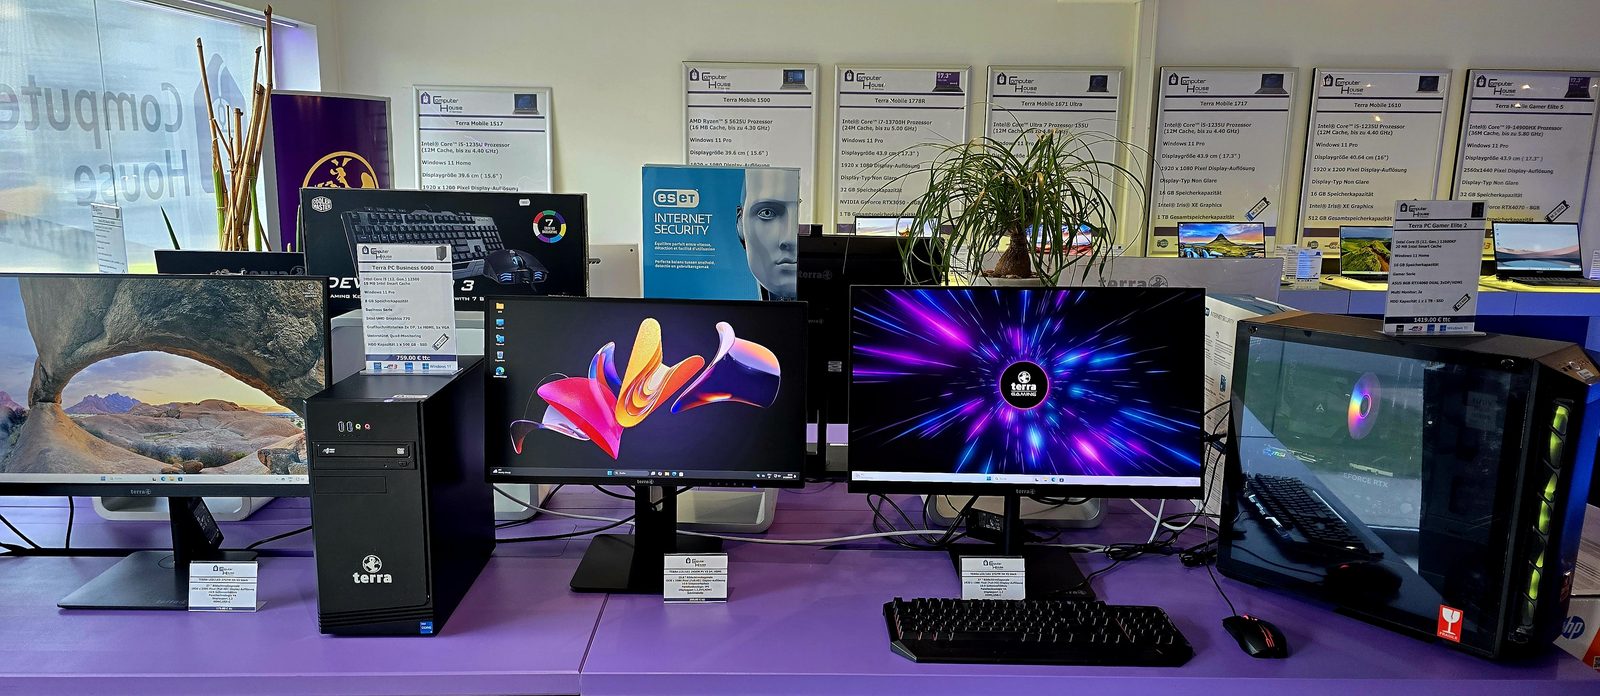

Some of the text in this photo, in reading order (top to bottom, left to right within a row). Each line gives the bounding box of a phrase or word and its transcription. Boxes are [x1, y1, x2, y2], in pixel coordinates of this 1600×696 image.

[545, 218, 554, 226] 7
[654, 214, 712, 223] INTERNET
[654, 225, 709, 235] SECURITY
[460, 280, 474, 291] 3
[1010, 382, 1036, 390] terra
[1343, 472, 1372, 485] EFORCE
[353, 572, 392, 584] terra
[1567, 616, 1583, 639] hp
